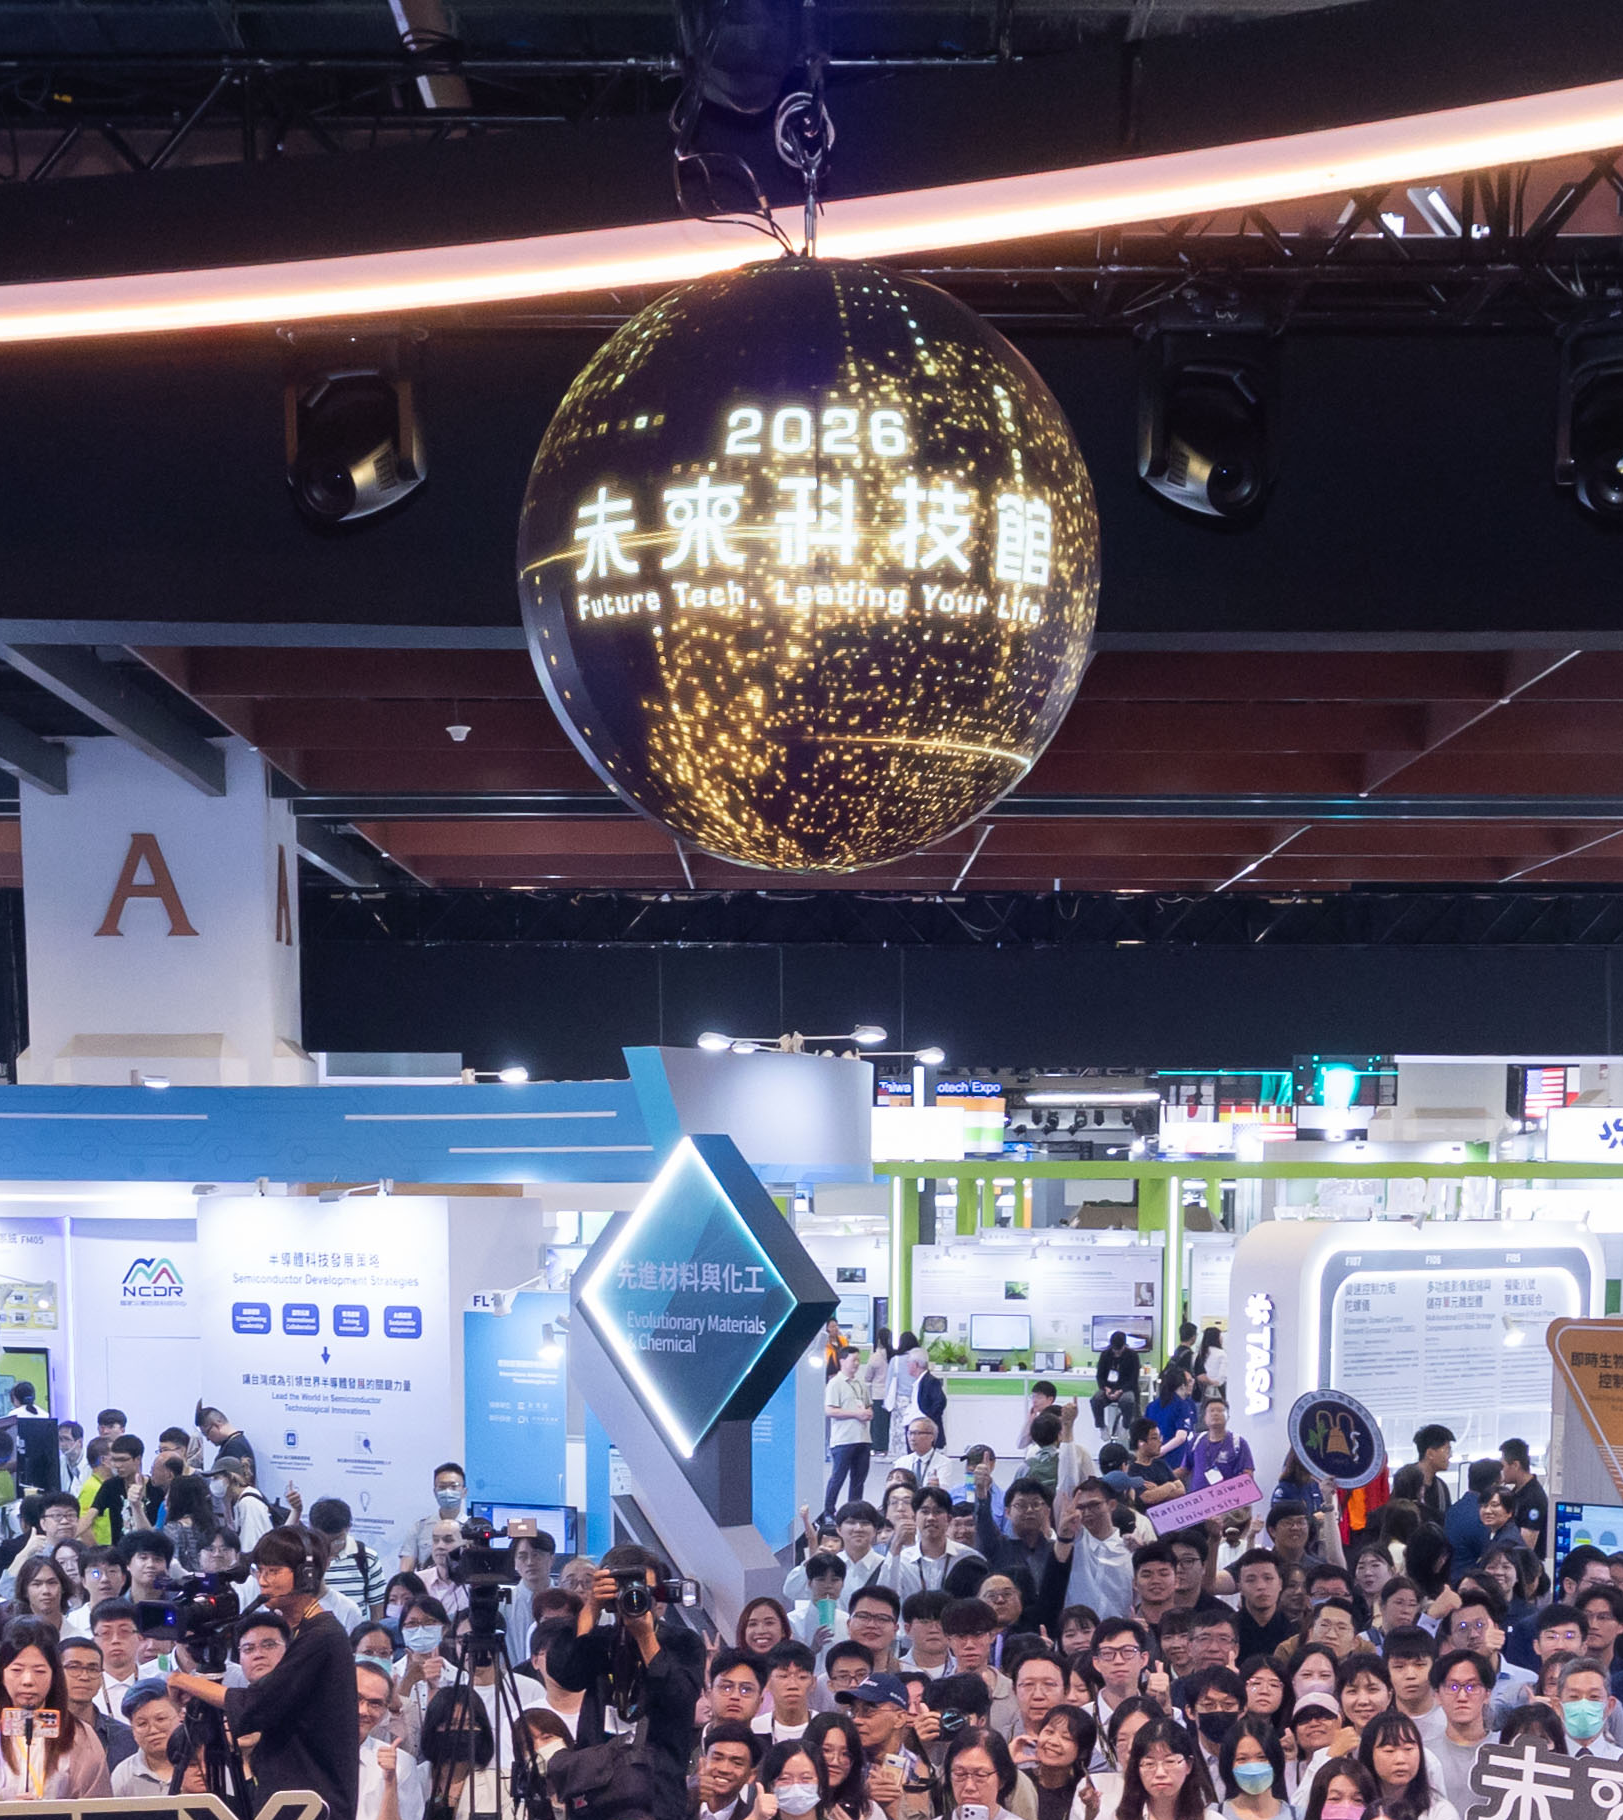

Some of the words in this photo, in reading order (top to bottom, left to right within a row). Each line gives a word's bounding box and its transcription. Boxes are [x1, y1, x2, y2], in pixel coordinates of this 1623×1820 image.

[724, 407, 909, 457] 2026
[574, 475, 1052, 587] 未來科技館
[578, 589, 661, 621] Future
[776, 581, 906, 615] Leading
[922, 584, 988, 615] Your
[94, 833, 199, 937] A
[972, 1082, 1002, 1095] Expo
[122, 1285, 184, 1297] NCDR
[233, 1272, 302, 1286] Semiconductor
[305, 1274, 367, 1288] Development
[370, 1275, 419, 1290] Strategies
[618, 1261, 766, 1294] 先進材料與化工
[626, 1311, 705, 1336] Evolutionary
[707, 1314, 767, 1335] Materials
[639, 1334, 697, 1353] Chemical
[1245, 1326, 1274, 1416] TASA
[1150, 1494, 1204, 1520] National
[1207, 1478, 1253, 1499] Taiwan
[1175, 1496, 1241, 1526] University
